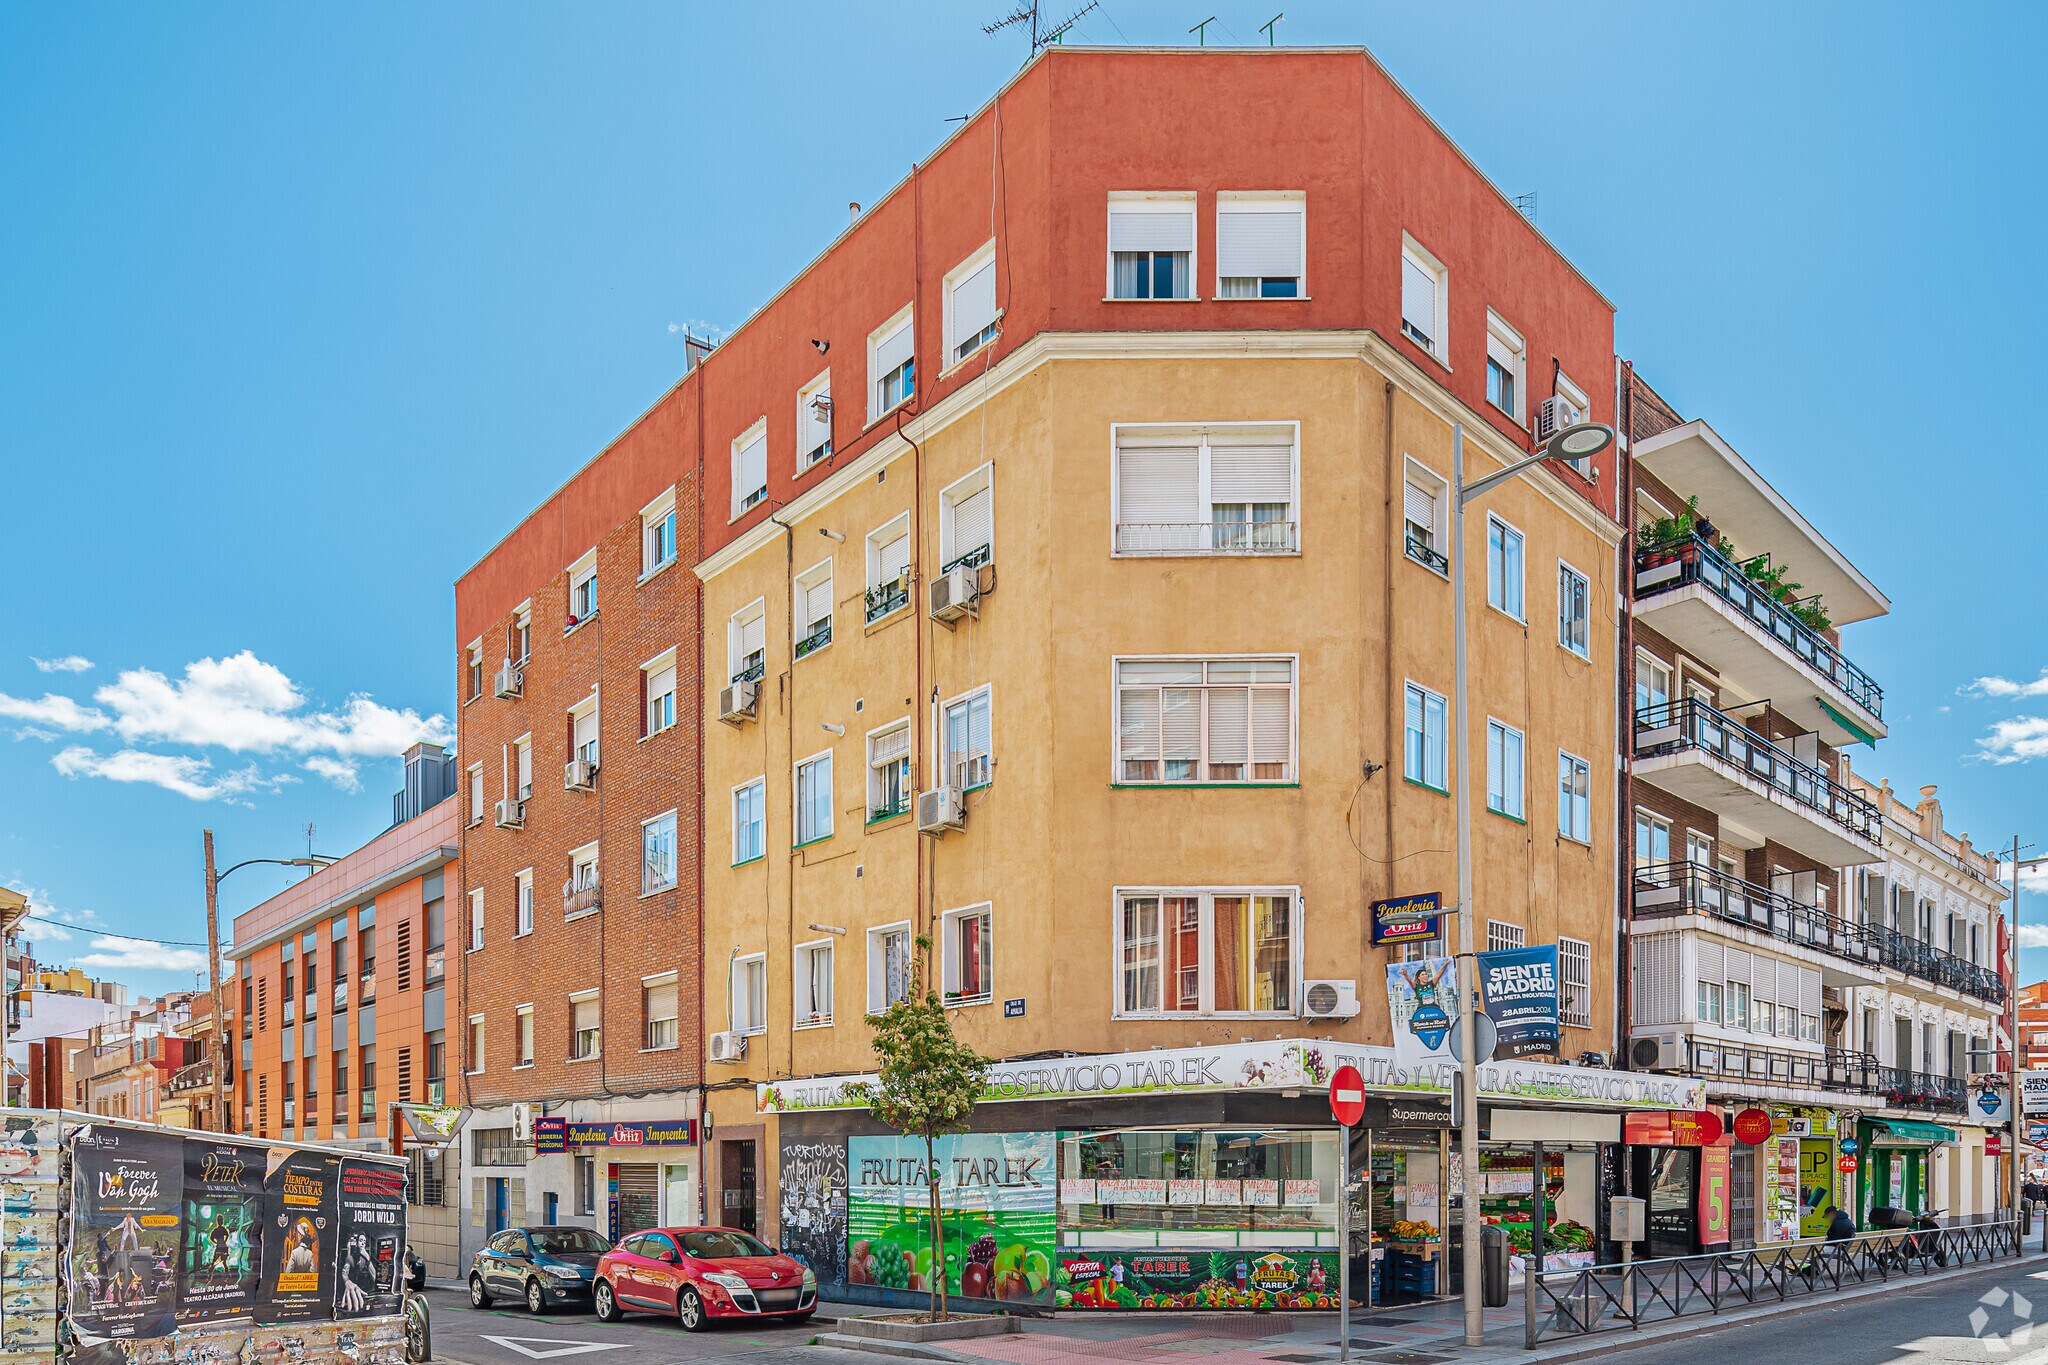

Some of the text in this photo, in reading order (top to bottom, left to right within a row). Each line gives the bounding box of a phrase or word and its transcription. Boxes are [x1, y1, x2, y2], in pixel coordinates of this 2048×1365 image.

[1489, 963, 1552, 982] SIENTE
[1486, 977, 1555, 997] MADRID
[1523, 1043, 1552, 1052] MADRID
[793, 1086, 844, 1107] FRUTAS
[1127, 1056, 1223, 1088] TAREK
[1529, 1069, 1633, 1101] AUTOSERVICIO
[1634, 1079, 1679, 1105] TAREK
[645, 1126, 688, 1145] Imprenta
[1841, 1159, 1856, 1167] ria
[117, 1165, 158, 1184] Forever
[285, 1175, 310, 1185] TIEMPO
[861, 1157, 941, 1186] FRUTAS
[953, 1158, 1043, 1188] TAREK
[98, 1171, 160, 1206] Van Gogh
[283, 1183, 323, 1196] COSTURAS
[1286, 1180, 1319, 1190] NUECES
[1709, 1177, 1723, 1231] 5
[354, 1210, 395, 1223] JORDI WILD
[1070, 1261, 1100, 1272] OFERTA
[1131, 1262, 1191, 1272] TAREK
[1075, 1271, 1101, 1279] ESPECIAL
